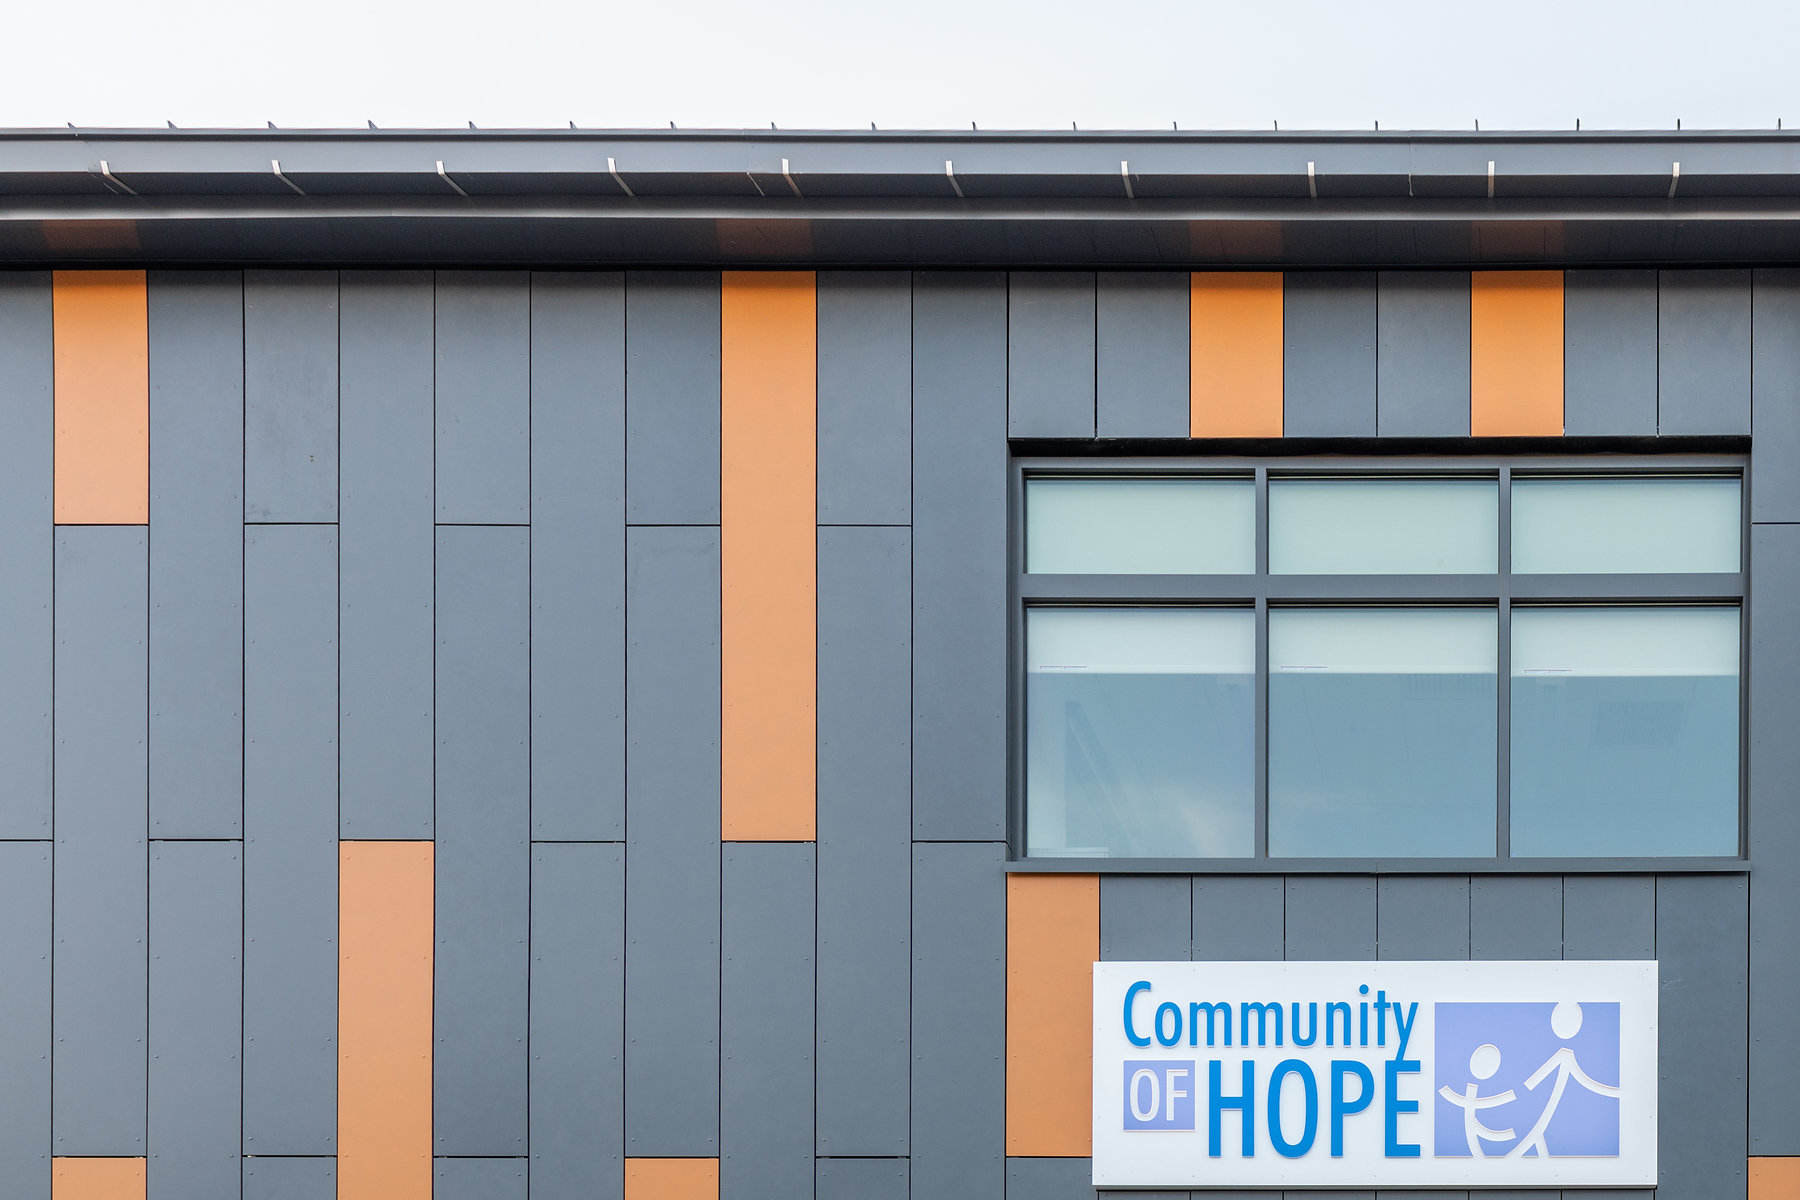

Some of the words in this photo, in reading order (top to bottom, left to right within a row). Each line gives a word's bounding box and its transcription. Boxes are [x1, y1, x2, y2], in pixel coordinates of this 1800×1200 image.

[1123, 981, 1419, 1061] Community
[1129, 1069, 1189, 1122] OF
[1208, 1059, 1421, 1158] HOPE
